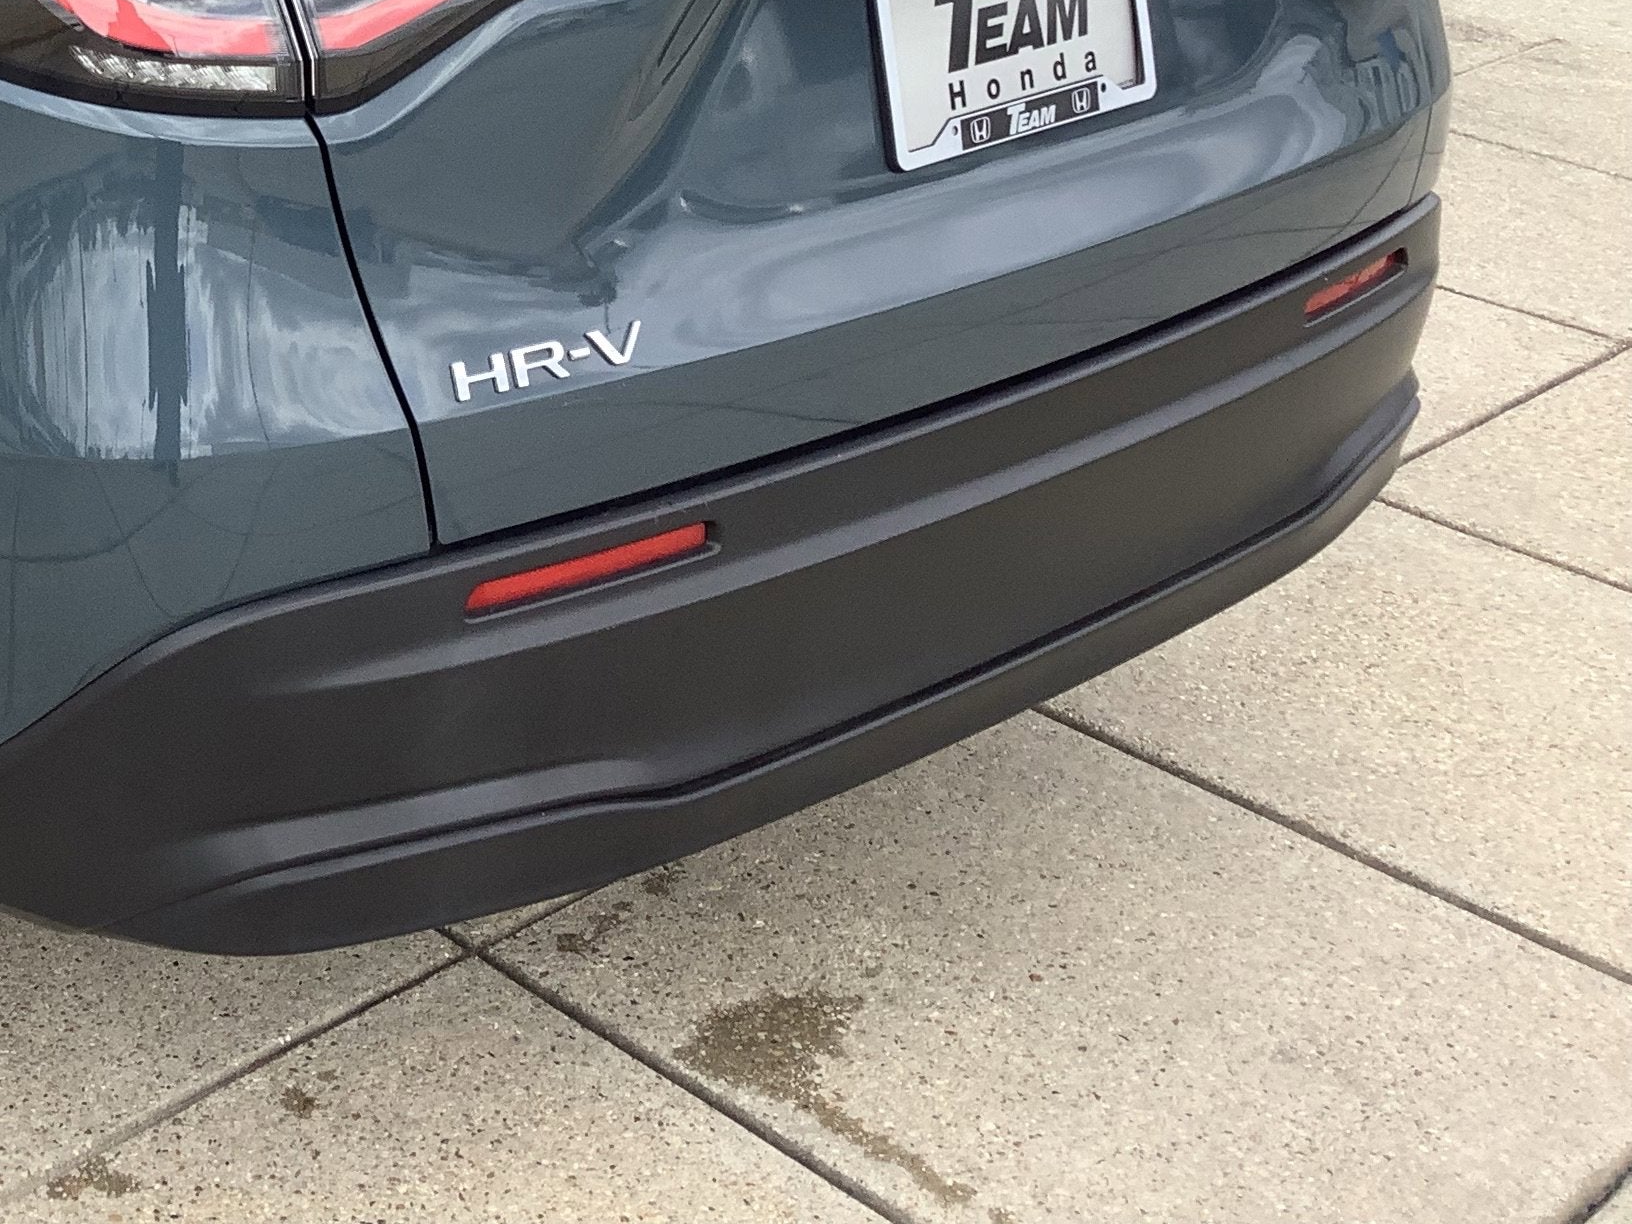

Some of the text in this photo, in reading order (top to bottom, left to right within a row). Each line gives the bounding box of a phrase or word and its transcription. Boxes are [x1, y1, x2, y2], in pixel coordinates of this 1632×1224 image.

[948, 50, 1098, 111] Honda
[1006, 102, 1057, 136] TEAM
[449, 318, 642, 402] HR-V
